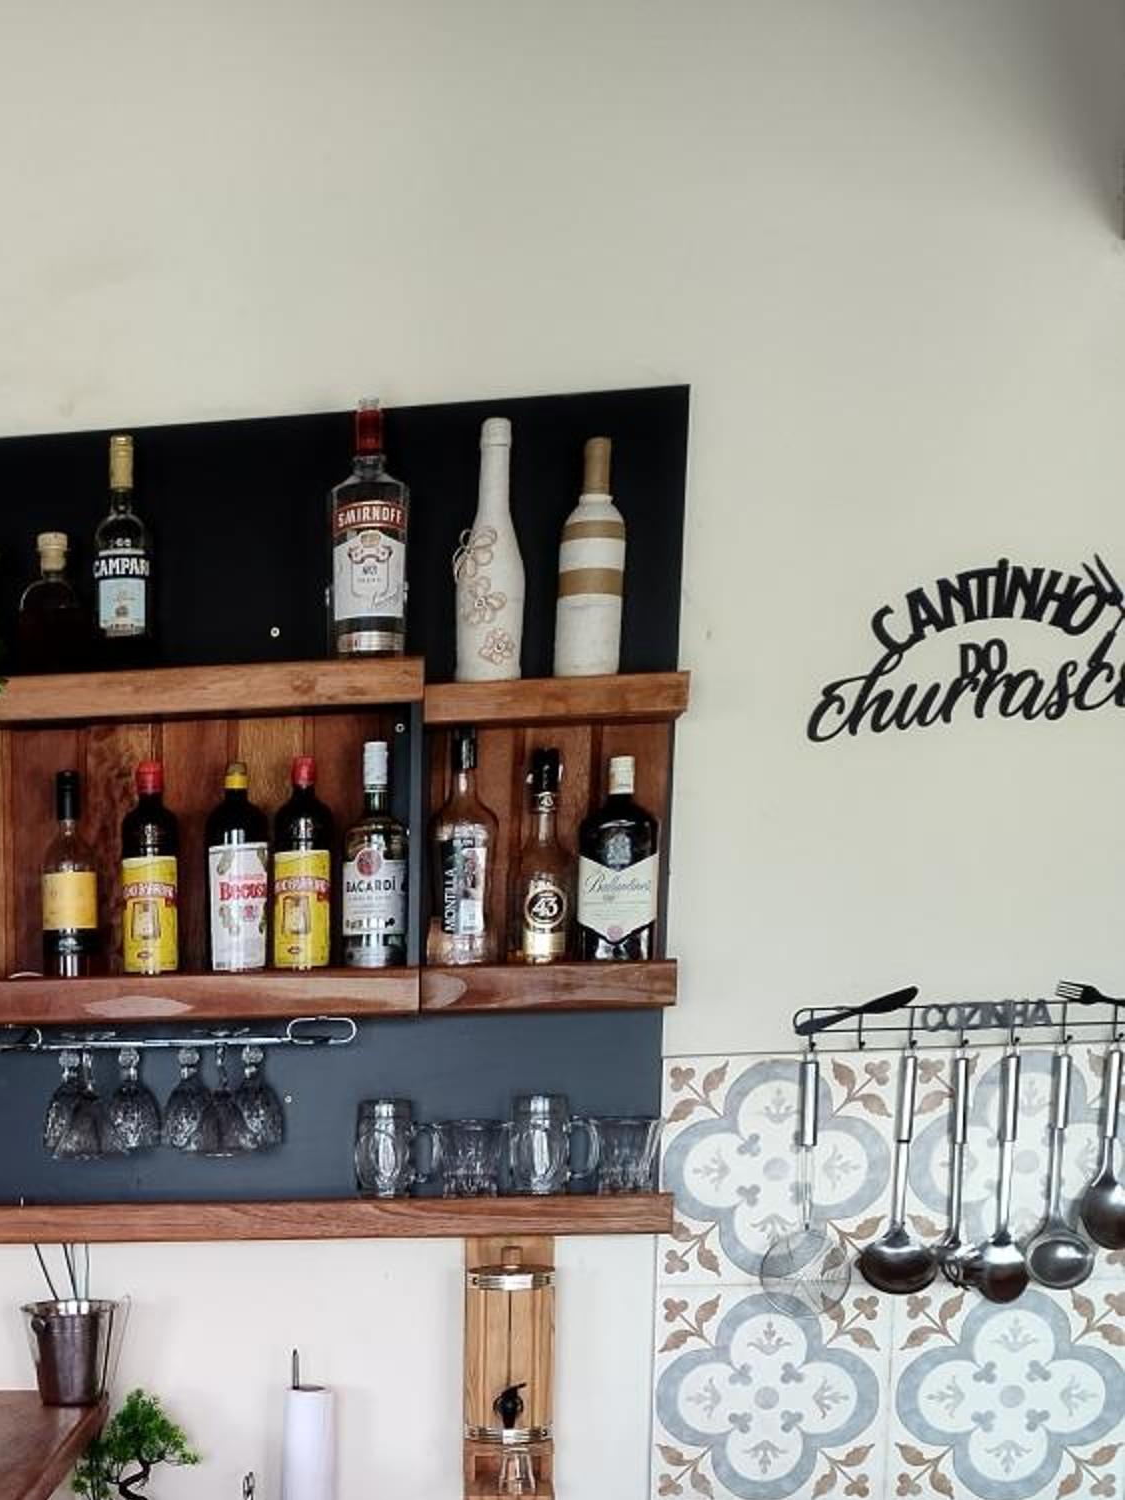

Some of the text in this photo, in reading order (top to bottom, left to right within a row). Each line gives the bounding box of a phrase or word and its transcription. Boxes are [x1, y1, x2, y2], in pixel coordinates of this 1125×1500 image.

[338, 506, 402, 527] SMIRNOFF
[93, 557, 150, 577] CAMPARI
[871, 557, 1103, 652] CANTINHO
[959, 638, 1008, 678] DO
[532, 896, 559, 918] 43
[921, 999, 1052, 1032] COZINHA
